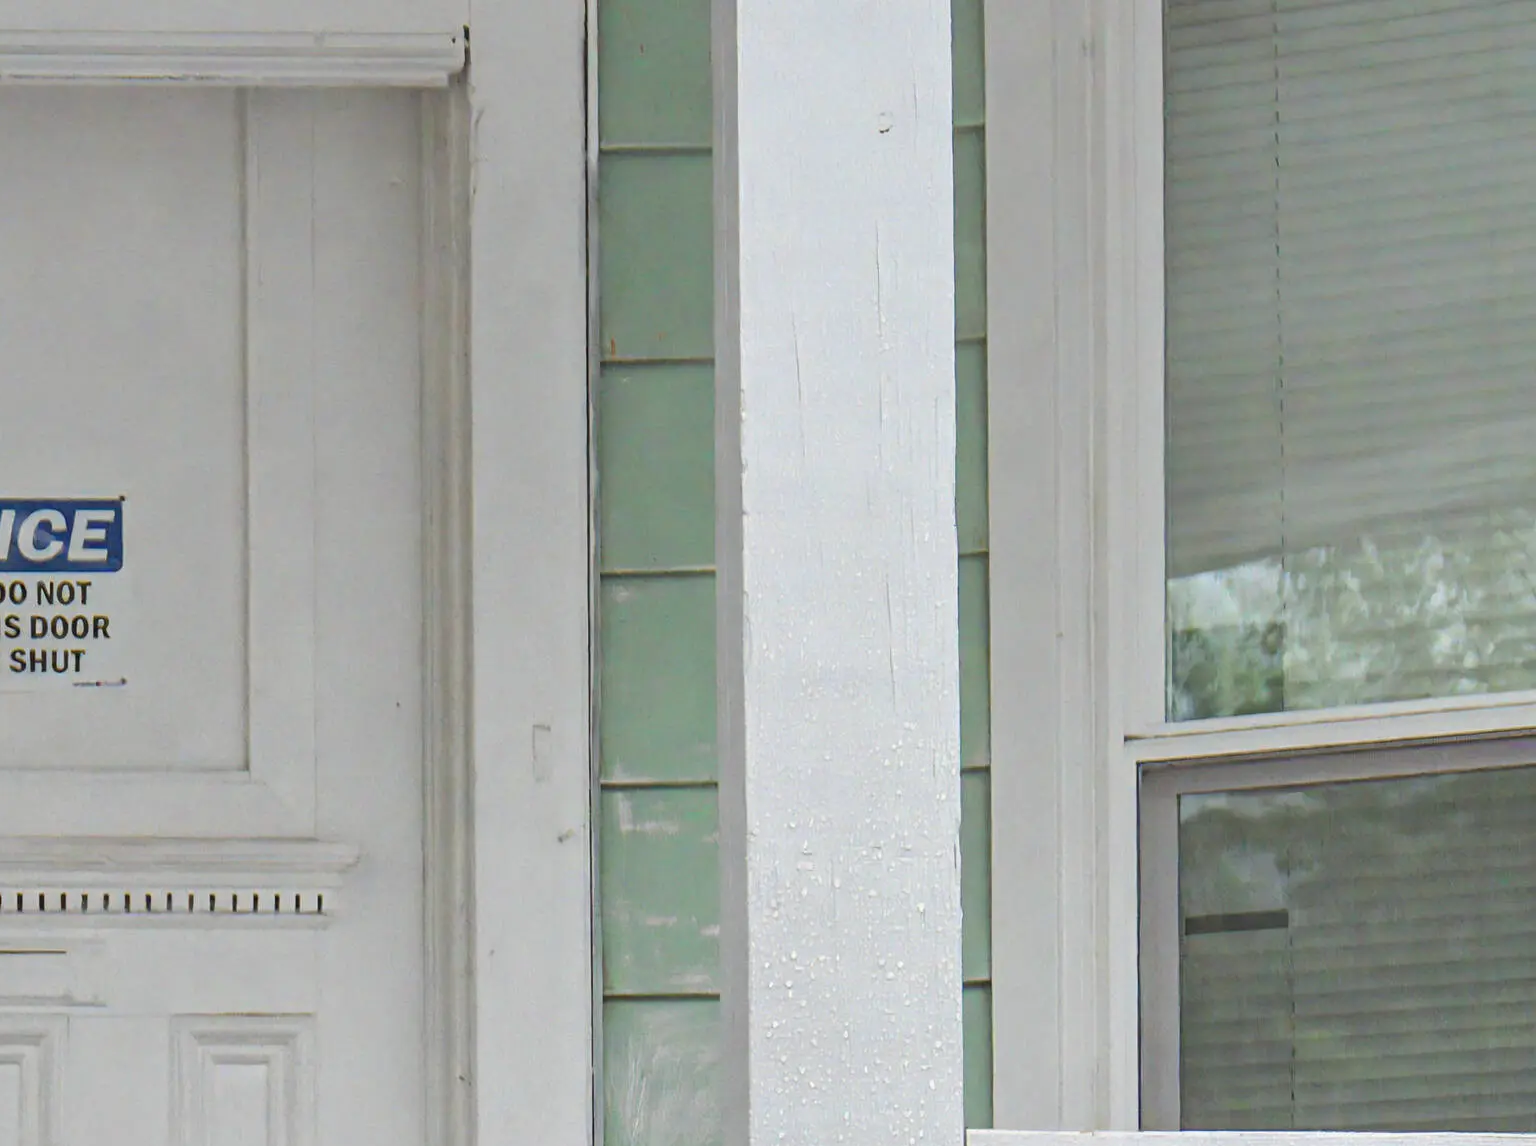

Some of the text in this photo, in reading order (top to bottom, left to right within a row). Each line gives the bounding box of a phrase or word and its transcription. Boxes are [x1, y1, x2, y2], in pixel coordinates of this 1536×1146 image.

[37, 580, 92, 605] NOT
[30, 613, 110, 639] DOOR
[9, 648, 86, 673] SHUT
